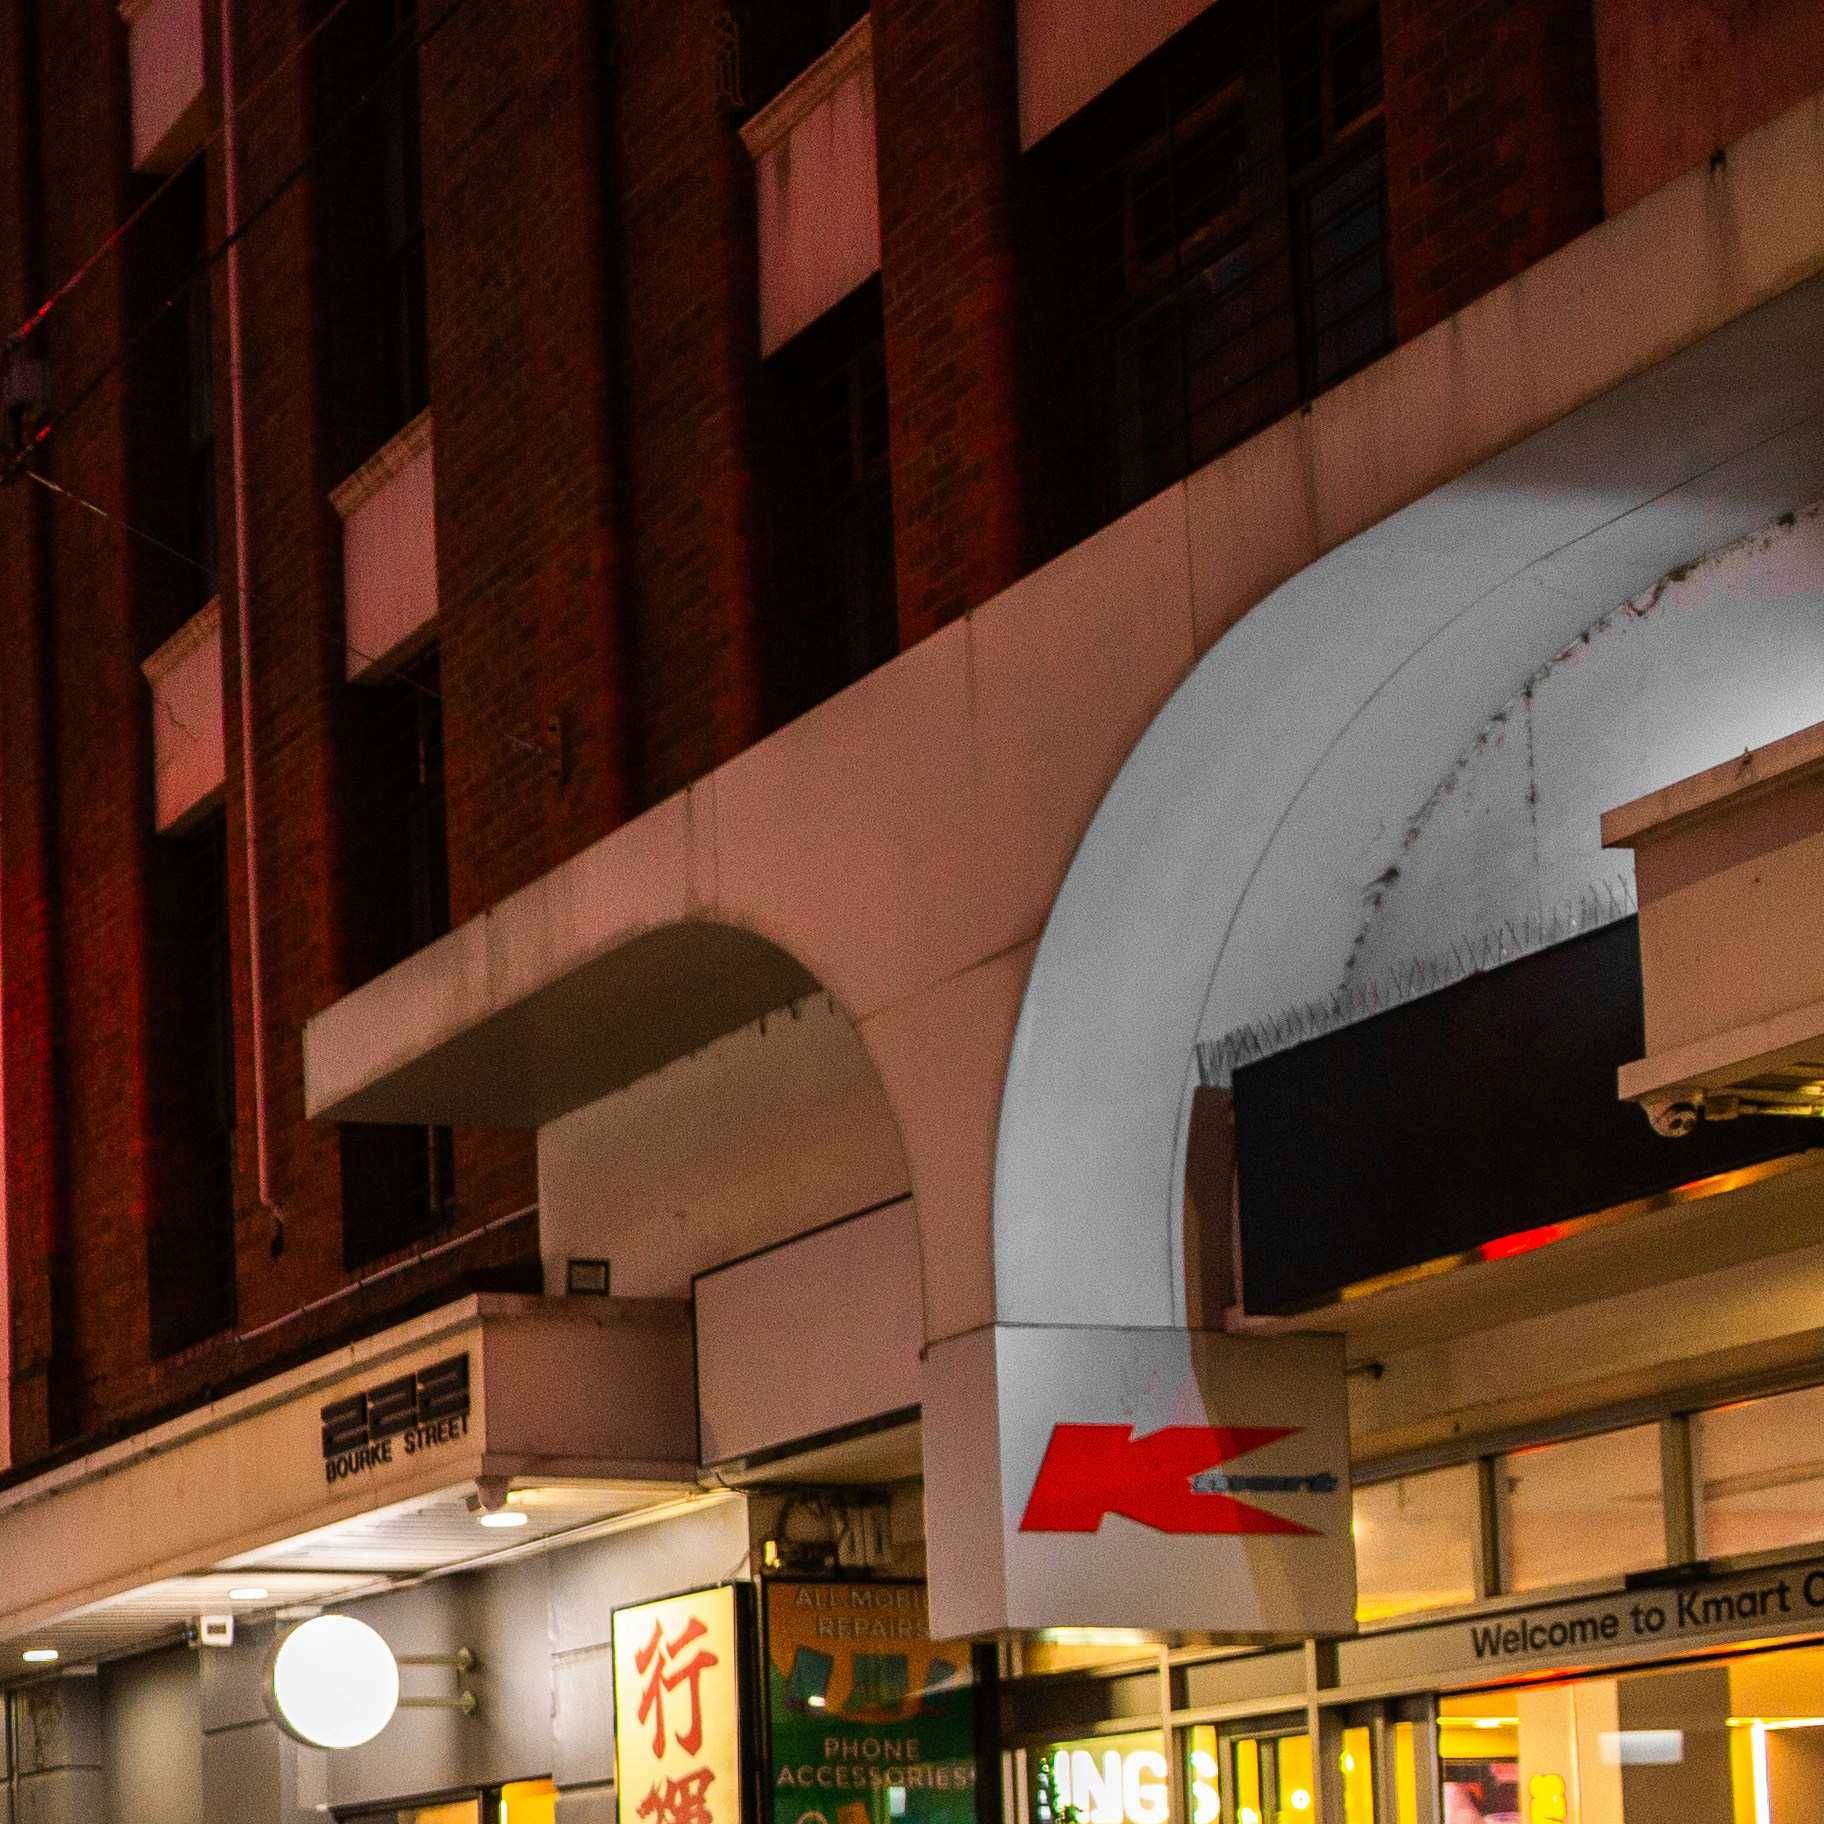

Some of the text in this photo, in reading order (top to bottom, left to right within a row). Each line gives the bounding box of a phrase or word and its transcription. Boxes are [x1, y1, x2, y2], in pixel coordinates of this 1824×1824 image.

[320, 1351, 471, 1459] 222
[325, 1409, 471, 1485] BOURKE STREET
[1470, 1611, 1620, 1659] Welcome
[1629, 1603, 1666, 1634] to
[1677, 1580, 1792, 1628] Kmart
[823, 1736, 921, 1761] PHONE
